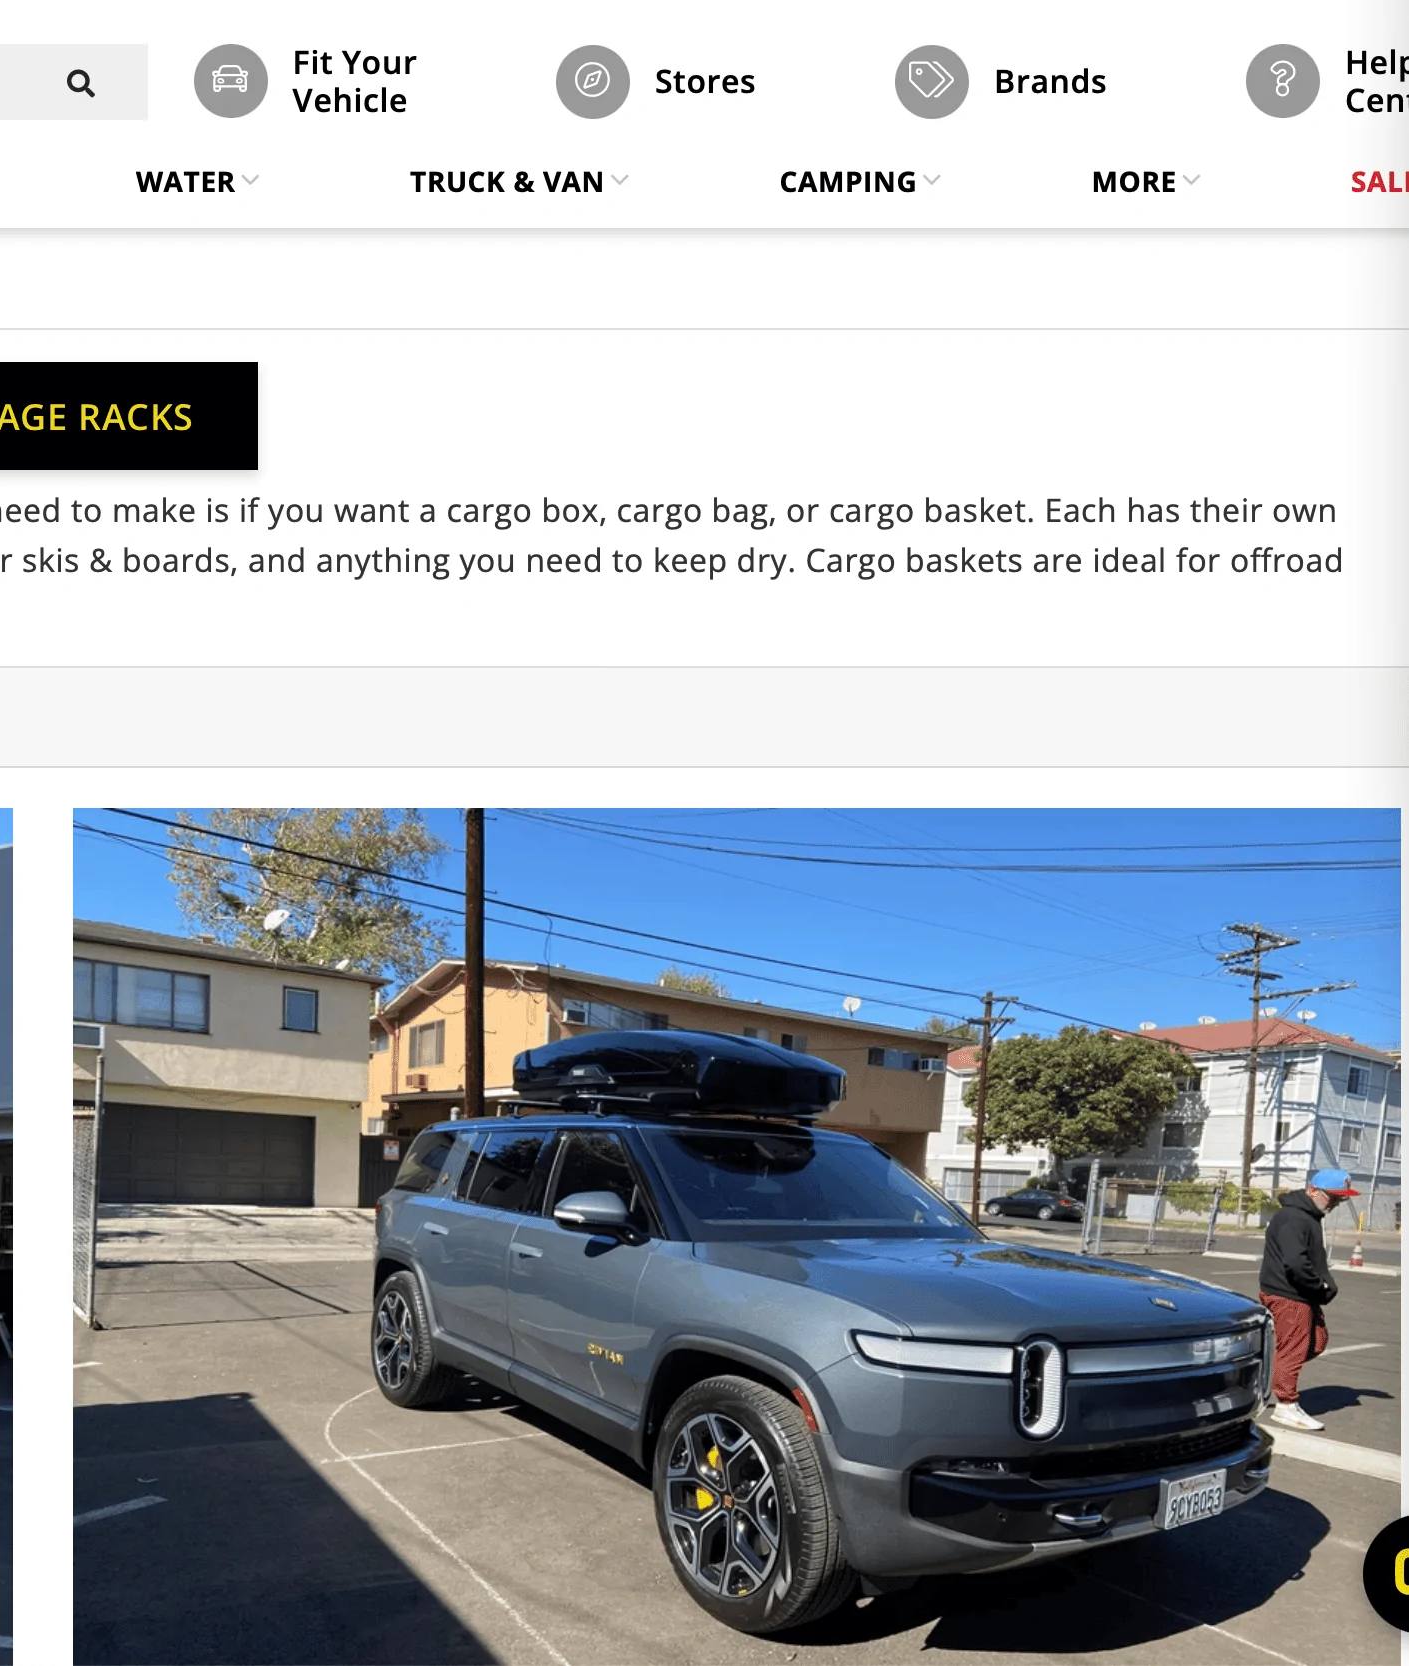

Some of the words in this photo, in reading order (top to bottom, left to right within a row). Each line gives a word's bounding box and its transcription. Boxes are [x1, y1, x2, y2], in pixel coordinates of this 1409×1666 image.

[294, 49, 333, 76] Fit
[341, 50, 418, 76] Your
[655, 68, 756, 95] Stores
[996, 67, 1107, 95] Brands
[291, 86, 407, 114] Vehicle
[1346, 87, 1409, 113] Cen
[135, 170, 236, 193] WATER
[409, 170, 506, 193] TRUCK
[513, 170, 536, 193] &
[542, 170, 603, 193] VAN
[780, 170, 916, 193] CAMPING
[1093, 170, 1176, 193] MORE
[1351, 170, 1409, 193] SAL
[80, 403, 192, 432] RACKS
[70, 499, 102, 523] to
[113, 496, 196, 523] make
[207, 497, 229, 523] is
[240, 496, 261, 523] if
[267, 503, 323, 531] you
[333, 499, 410, 523] want
[419, 503, 436, 523] a
[447, 503, 531, 531] cargo
[543, 496, 606, 527] box,
[617, 503, 702, 531] cargo
[713, 496, 776, 531] bag,
[786, 503, 820, 523] or
[829, 503, 914, 531] cargo
[925, 496, 1034, 524] basket.
[1046, 496, 1115, 523] Each
[1128, 496, 1180, 523] has
[1189, 496, 1263, 523] their
[1272, 503, 1336, 523] own
[22, 546, 79, 573] skis
[89, 547, 113, 573] &
[123, 546, 237, 577] boards,
[248, 546, 305, 573] and
[316, 546, 451, 581] anything
[458, 553, 514, 581] you
[527, 546, 601, 573] need
[611, 549, 643, 573] to
[654, 546, 727, 581] keep
[737, 546, 795, 581] dry.
[806, 547, 895, 581] Cargo
[906, 546, 1023, 574] baskets
[1033, 553, 1082, 573] are
[1094, 546, 1165, 573] ideal
[1175, 546, 1221, 573] for
[1230, 546, 1342, 573] offroad
[1170, 1486, 1222, 1522] 9CYB053
